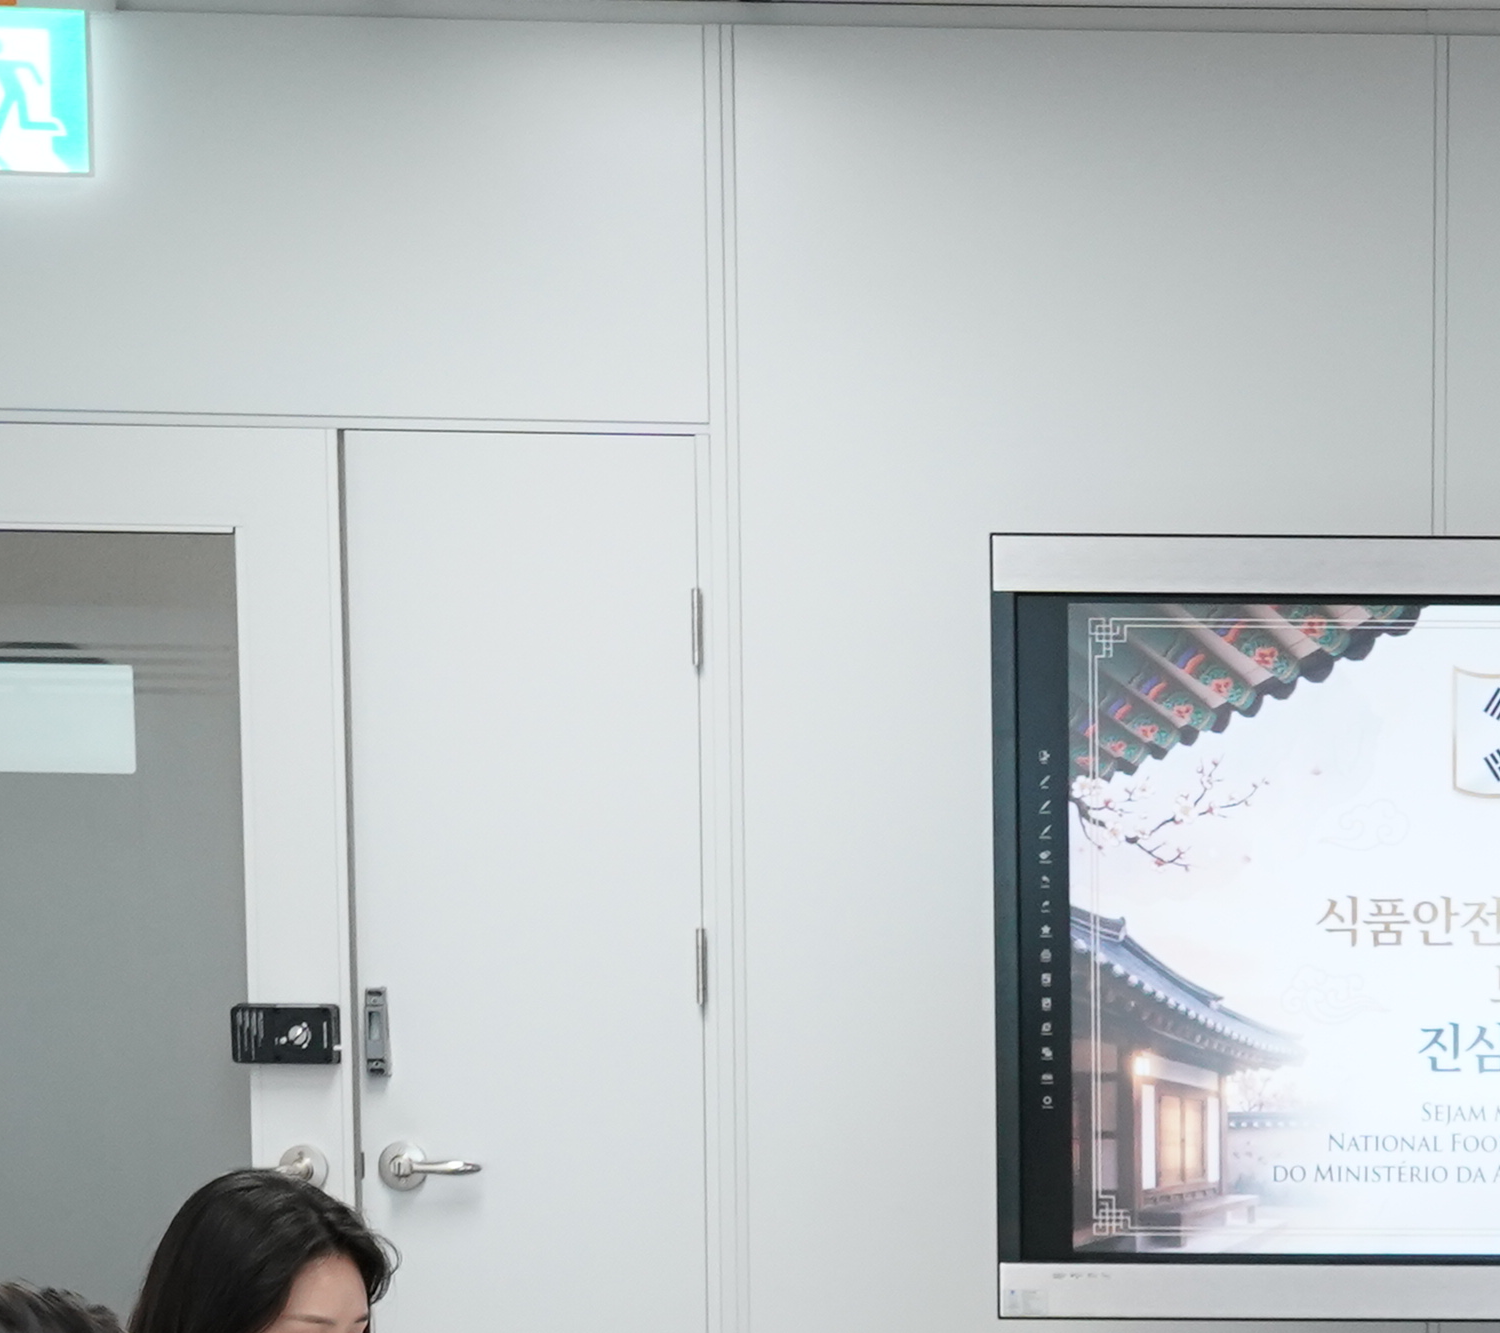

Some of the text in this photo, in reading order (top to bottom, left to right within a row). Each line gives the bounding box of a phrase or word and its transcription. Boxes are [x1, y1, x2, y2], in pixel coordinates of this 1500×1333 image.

[1328, 1133, 1444, 1153] NATIONAL
[1272, 1165, 1307, 1184] DO
[1313, 1160, 1449, 1184] MINISTÉRIO
[1457, 1165, 1487, 1184] DA
